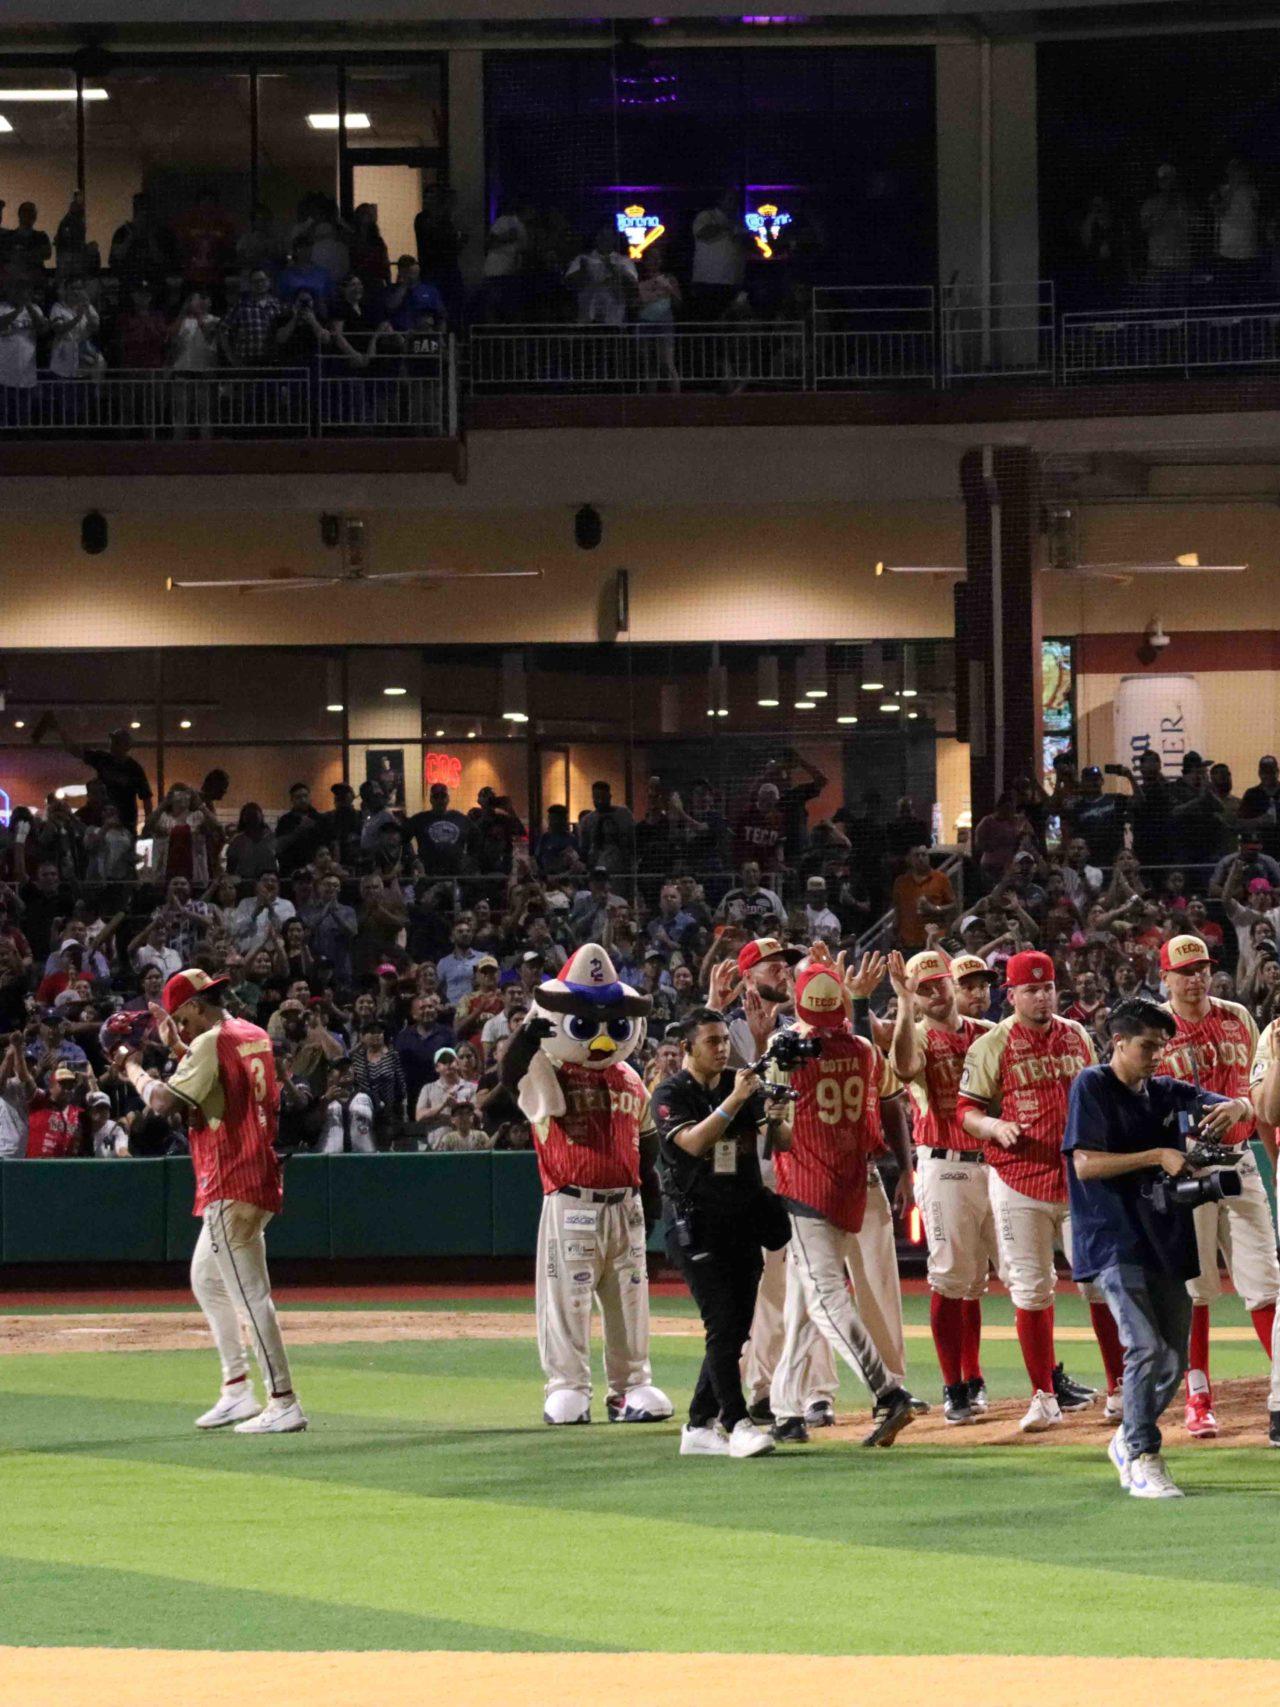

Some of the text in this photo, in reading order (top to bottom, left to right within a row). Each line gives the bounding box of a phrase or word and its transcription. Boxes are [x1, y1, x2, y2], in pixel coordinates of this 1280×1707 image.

[745, 826, 778, 845] TECO
[808, 996, 838, 1008] TECOS
[251, 1058, 268, 1102] 3
[816, 1075, 864, 1125] 99
